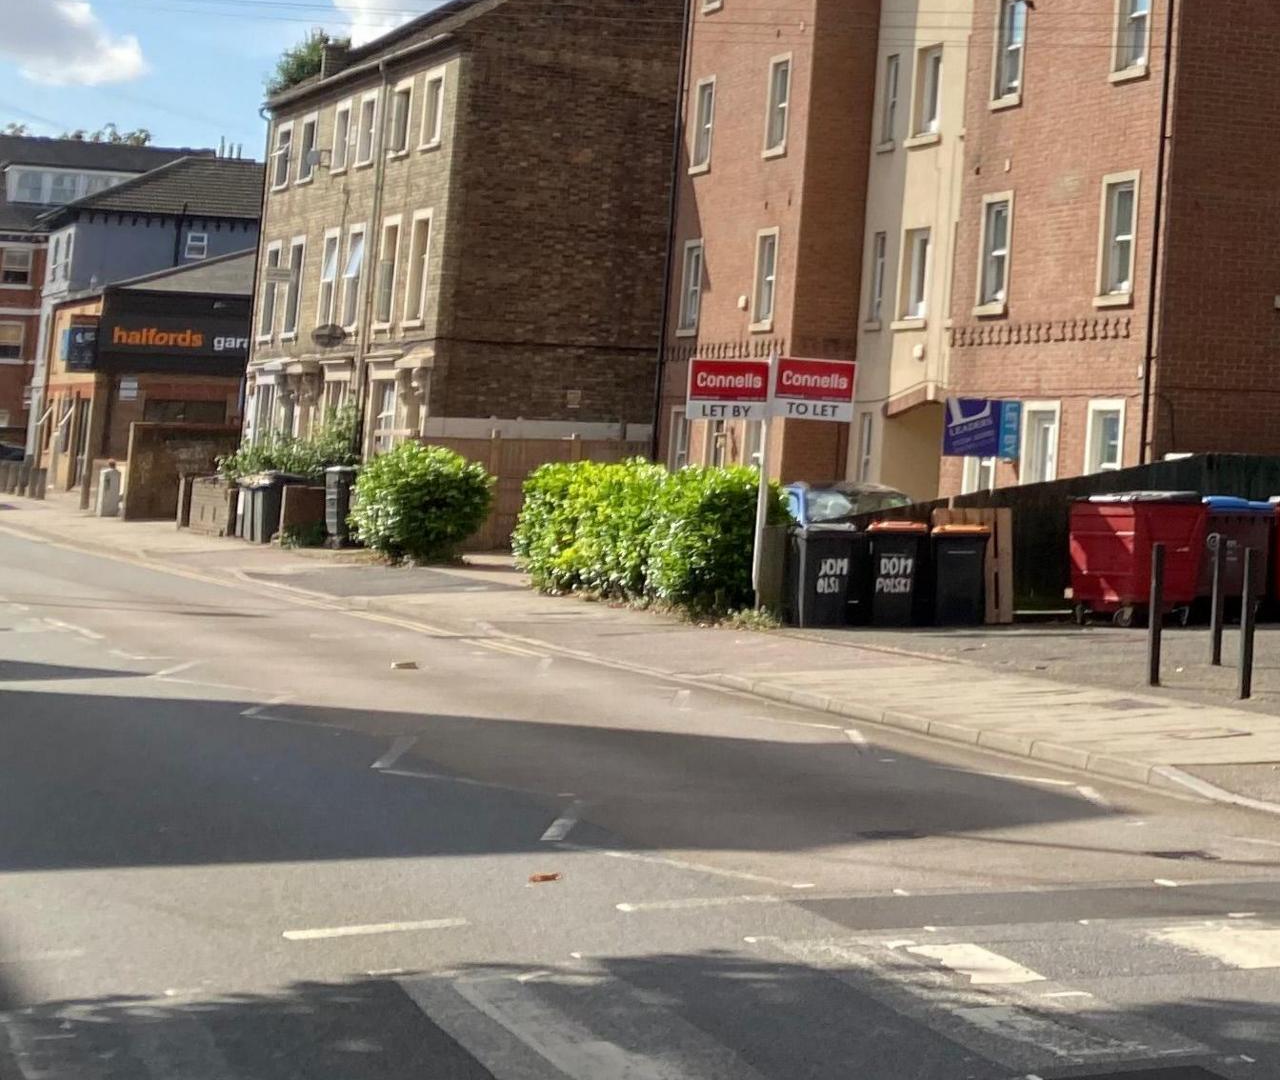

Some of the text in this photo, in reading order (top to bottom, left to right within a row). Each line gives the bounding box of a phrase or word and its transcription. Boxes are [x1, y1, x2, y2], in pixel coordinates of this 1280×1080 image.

[113, 326, 203, 348] halfords
[697, 371, 763, 389] Connells
[782, 370, 849, 390] Connells
[702, 405, 751, 417] LET BY
[787, 402, 840, 418] TO LET
[880, 557, 913, 575] DOM
[875, 577, 911, 593] POLSKI
